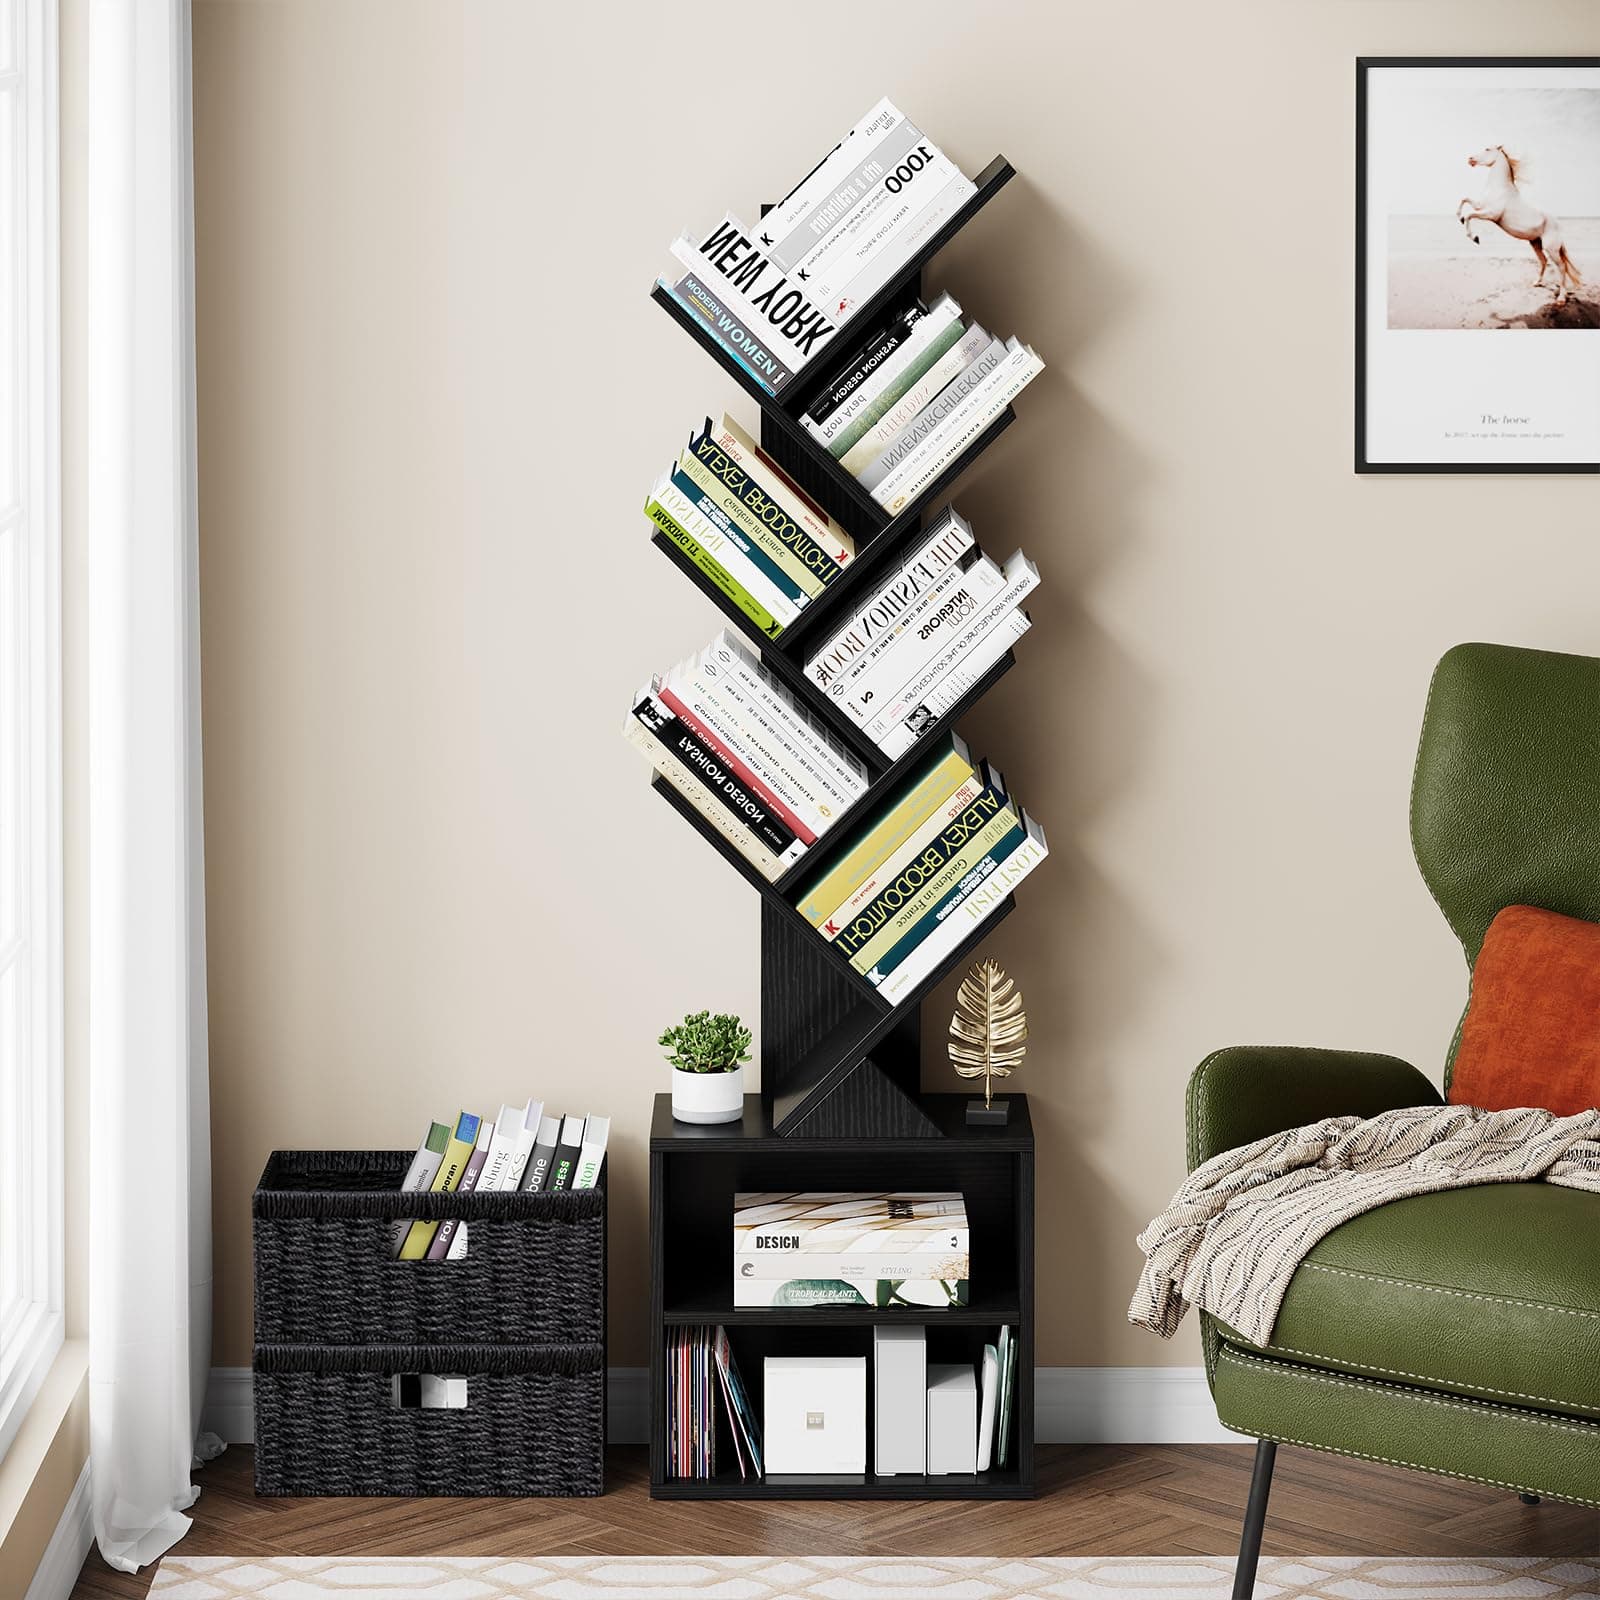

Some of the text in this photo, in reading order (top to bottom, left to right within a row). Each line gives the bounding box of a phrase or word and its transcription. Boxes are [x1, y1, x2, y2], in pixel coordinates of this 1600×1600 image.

[685, 279, 722, 316] MODERN
[717, 313, 777, 375] WOMEN
[945, 423, 980, 457] RAYMOND
[910, 458, 944, 492] CHANDLER
[940, 789, 998, 855] ALEXEY
[1005, 845, 1040, 881] LOST
[843, 847, 944, 947] BRODOVITCH
[896, 858, 967, 927] Gardens in France
[441, 1164, 458, 1192] poran
[756, 1236, 800, 1249] DESIGN
